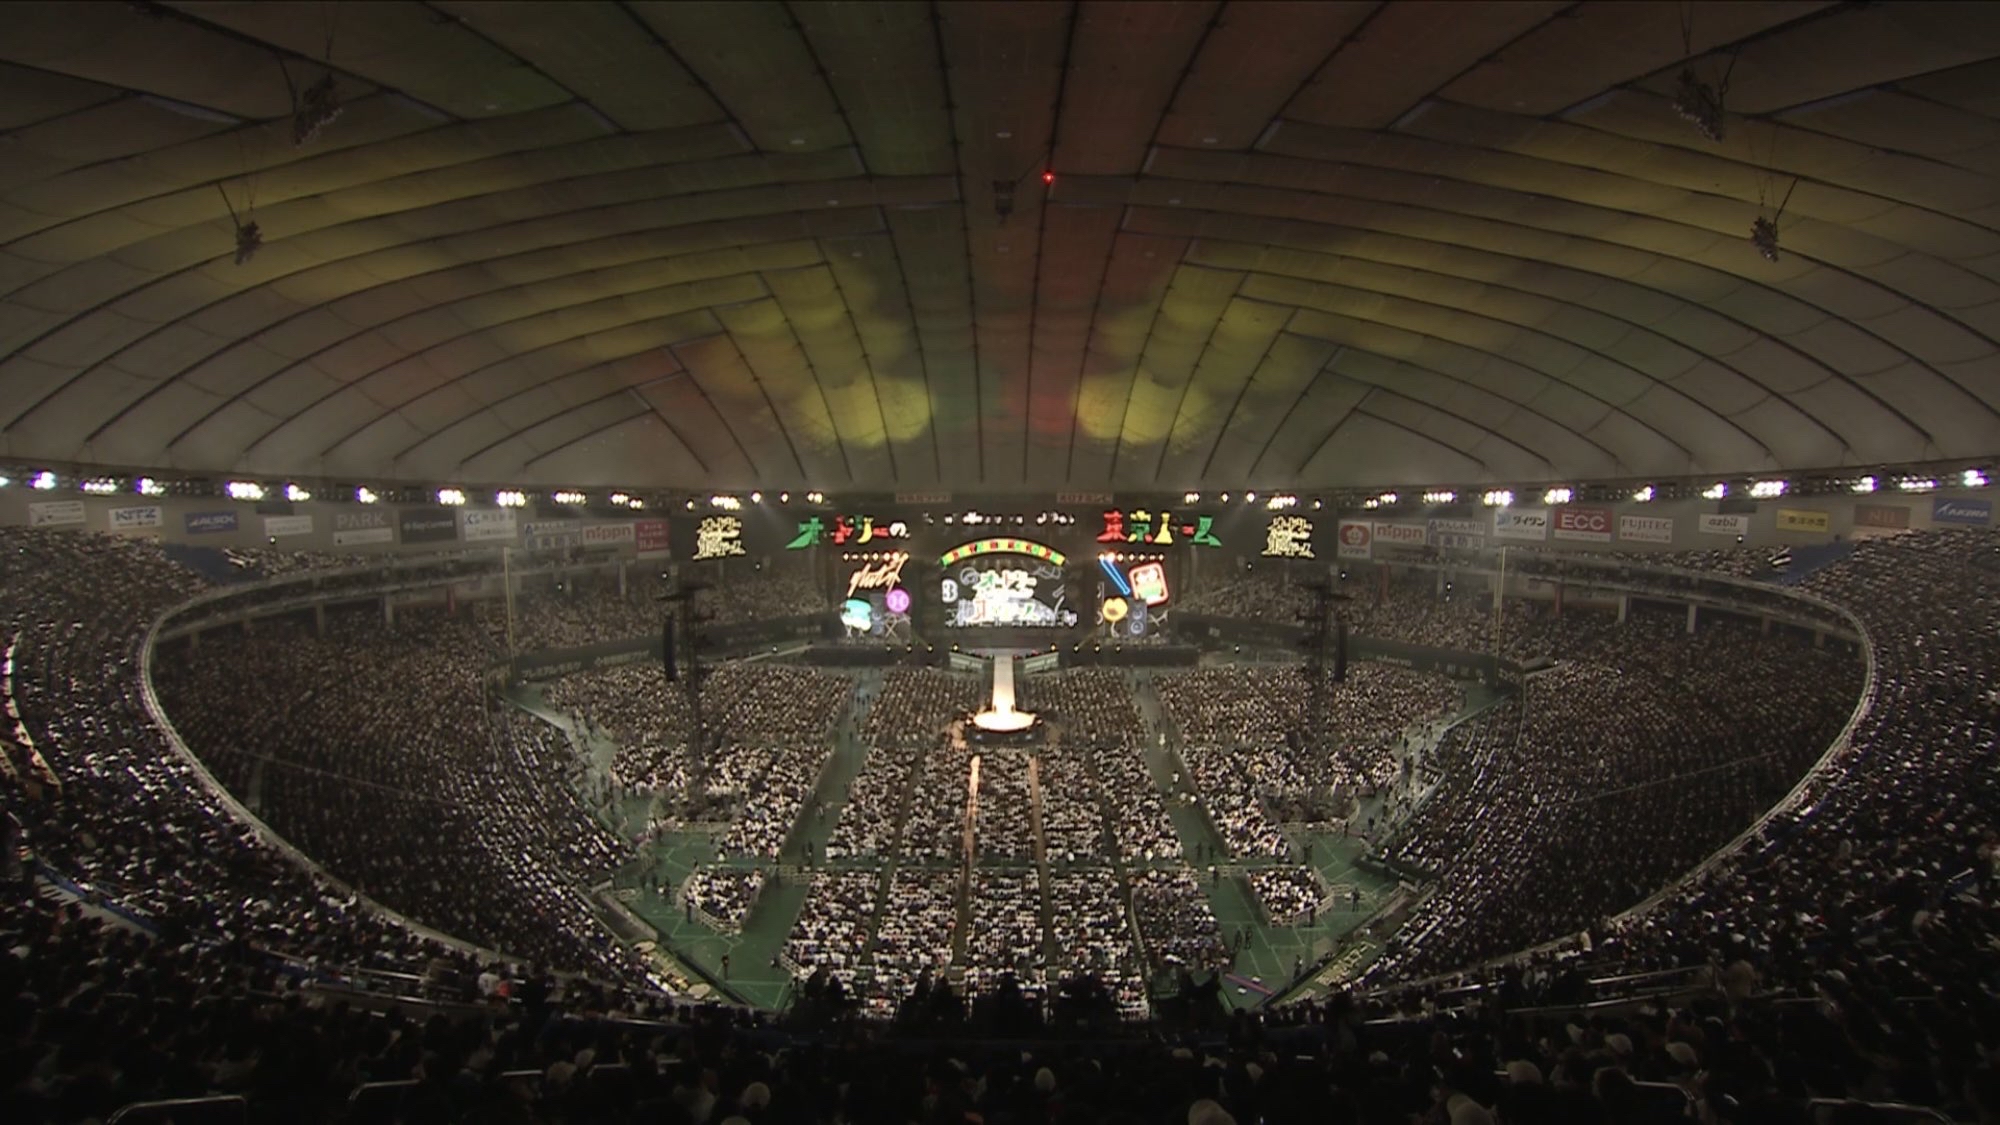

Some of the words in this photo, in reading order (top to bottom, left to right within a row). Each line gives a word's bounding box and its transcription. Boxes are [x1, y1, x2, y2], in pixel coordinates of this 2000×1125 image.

[115, 508, 156, 522] KITZ
[336, 512, 385, 529] PARK
[1561, 513, 1605, 530] ECC
[1622, 519, 1672, 530] FUJITEC
[1708, 518, 1739, 527] azbil
[585, 526, 631, 540] nippn
[1377, 525, 1423, 539] nippn
